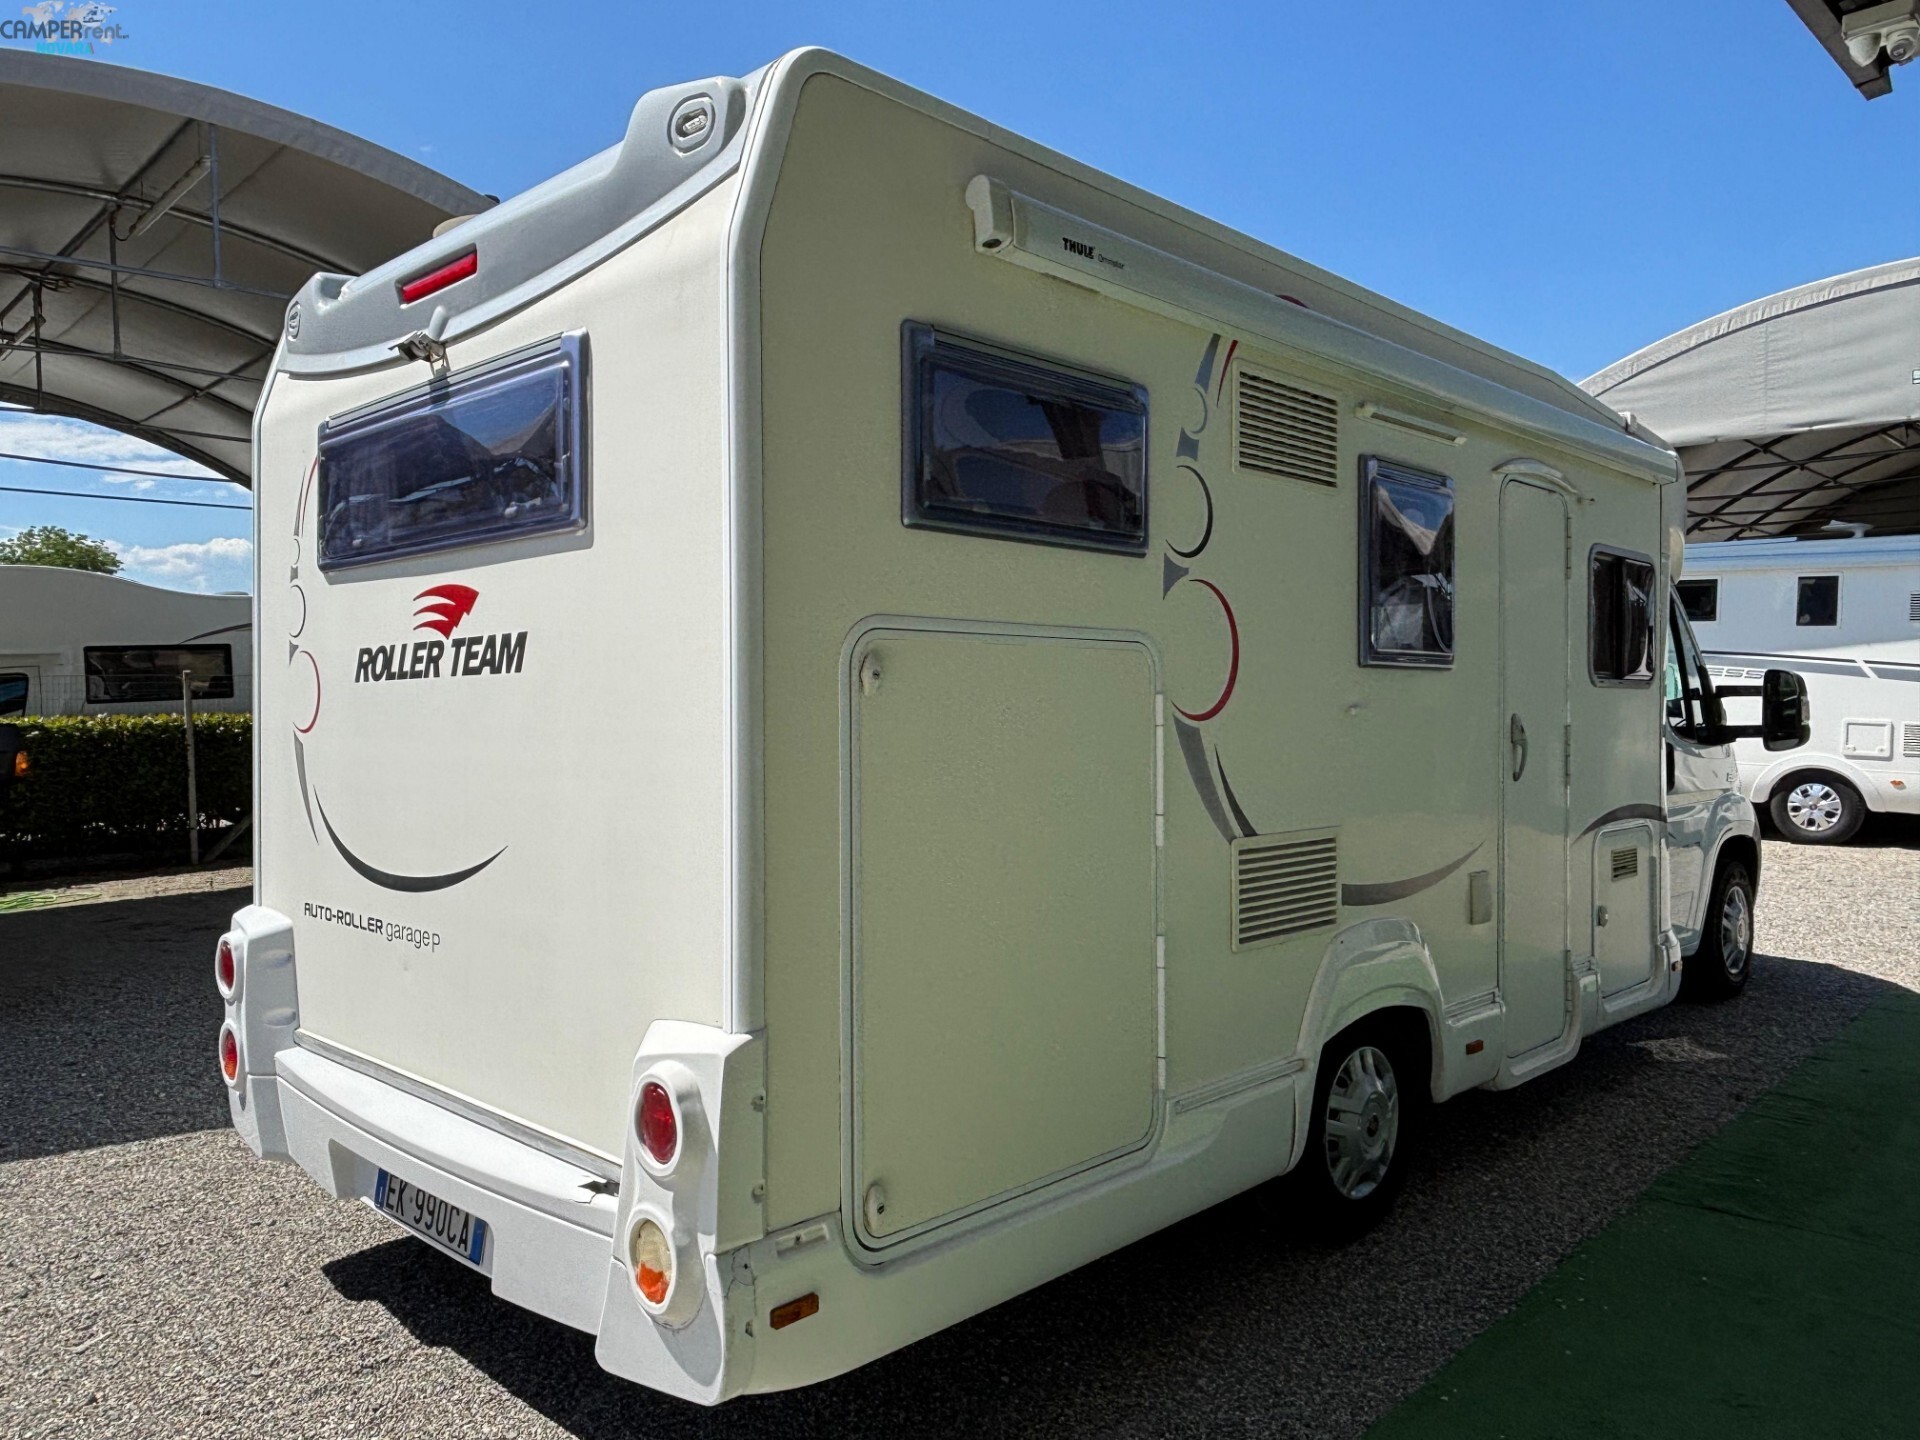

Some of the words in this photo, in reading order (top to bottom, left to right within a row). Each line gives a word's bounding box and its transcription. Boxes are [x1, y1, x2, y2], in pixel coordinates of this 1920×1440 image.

[1062, 237, 1094, 259] THULE
[354, 640, 445, 683] ROLLER
[451, 631, 528, 676] TEAM
[304, 902, 383, 935] AUTO-ROLLER
